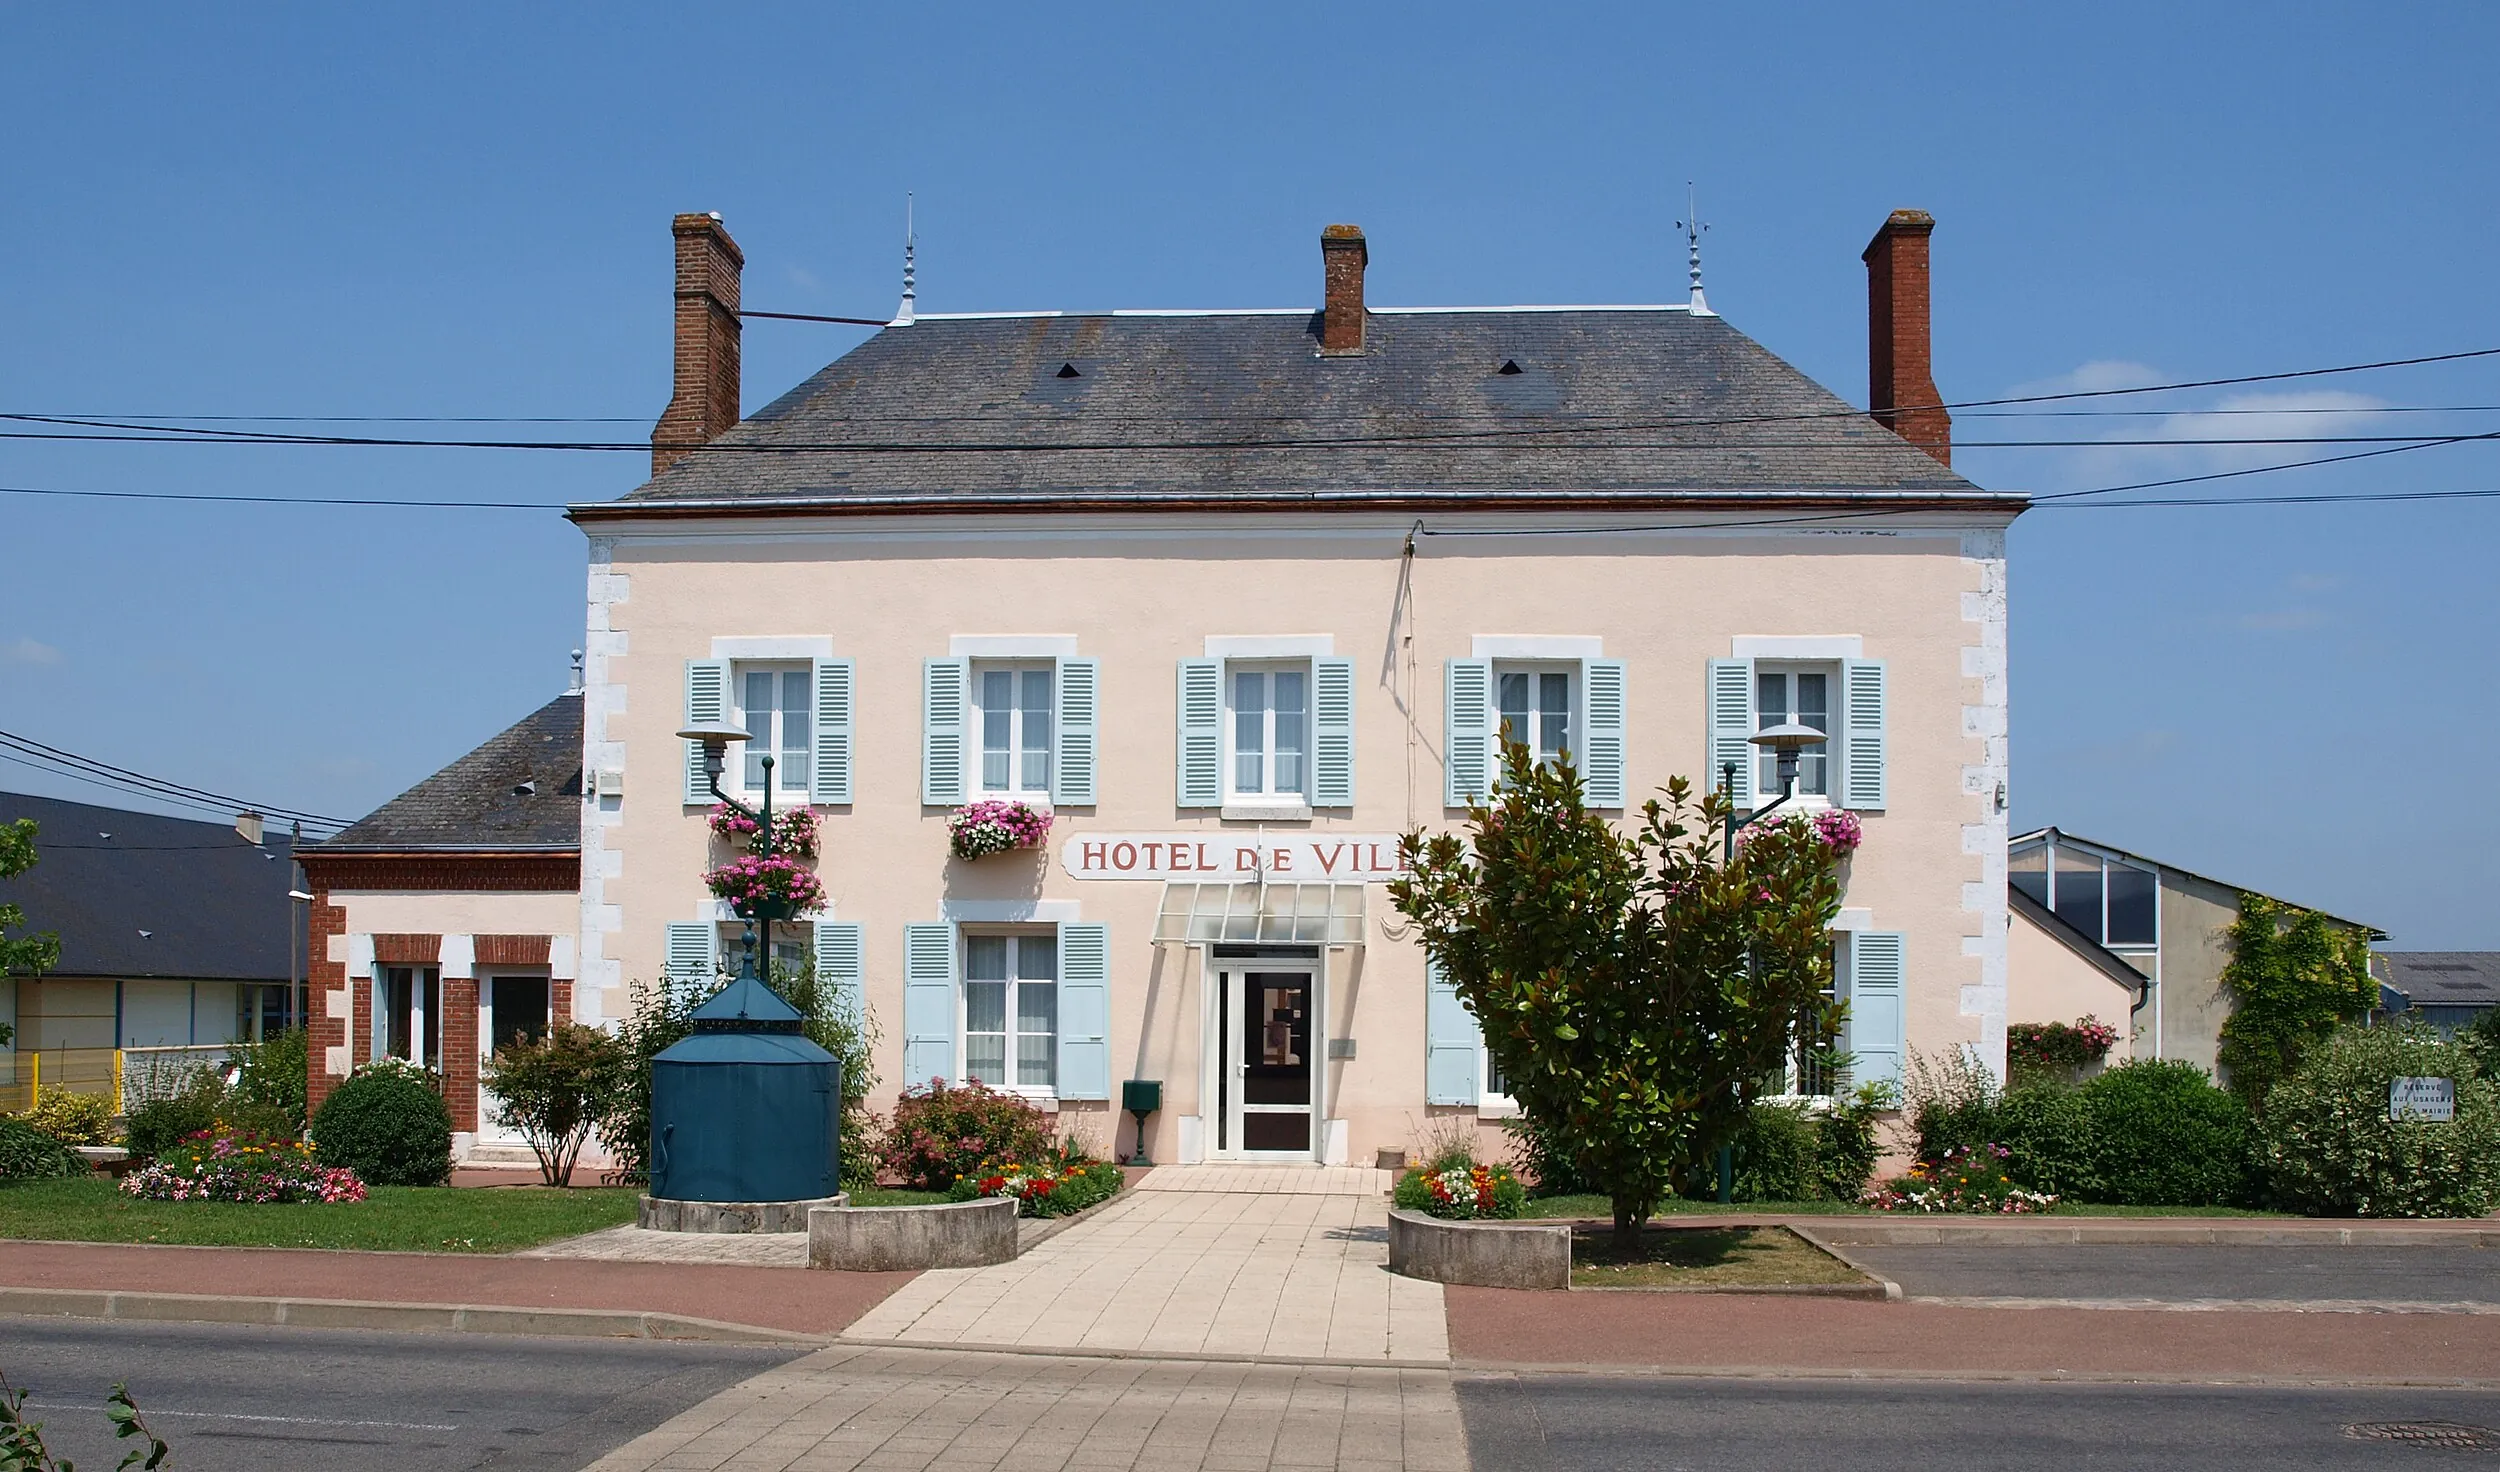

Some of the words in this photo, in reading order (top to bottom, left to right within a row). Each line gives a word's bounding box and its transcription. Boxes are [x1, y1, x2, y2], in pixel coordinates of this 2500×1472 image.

[1081, 840, 1219, 871] HÔTEL
[1234, 848, 1293, 872] DE
[1310, 843, 1442, 875] VILL
